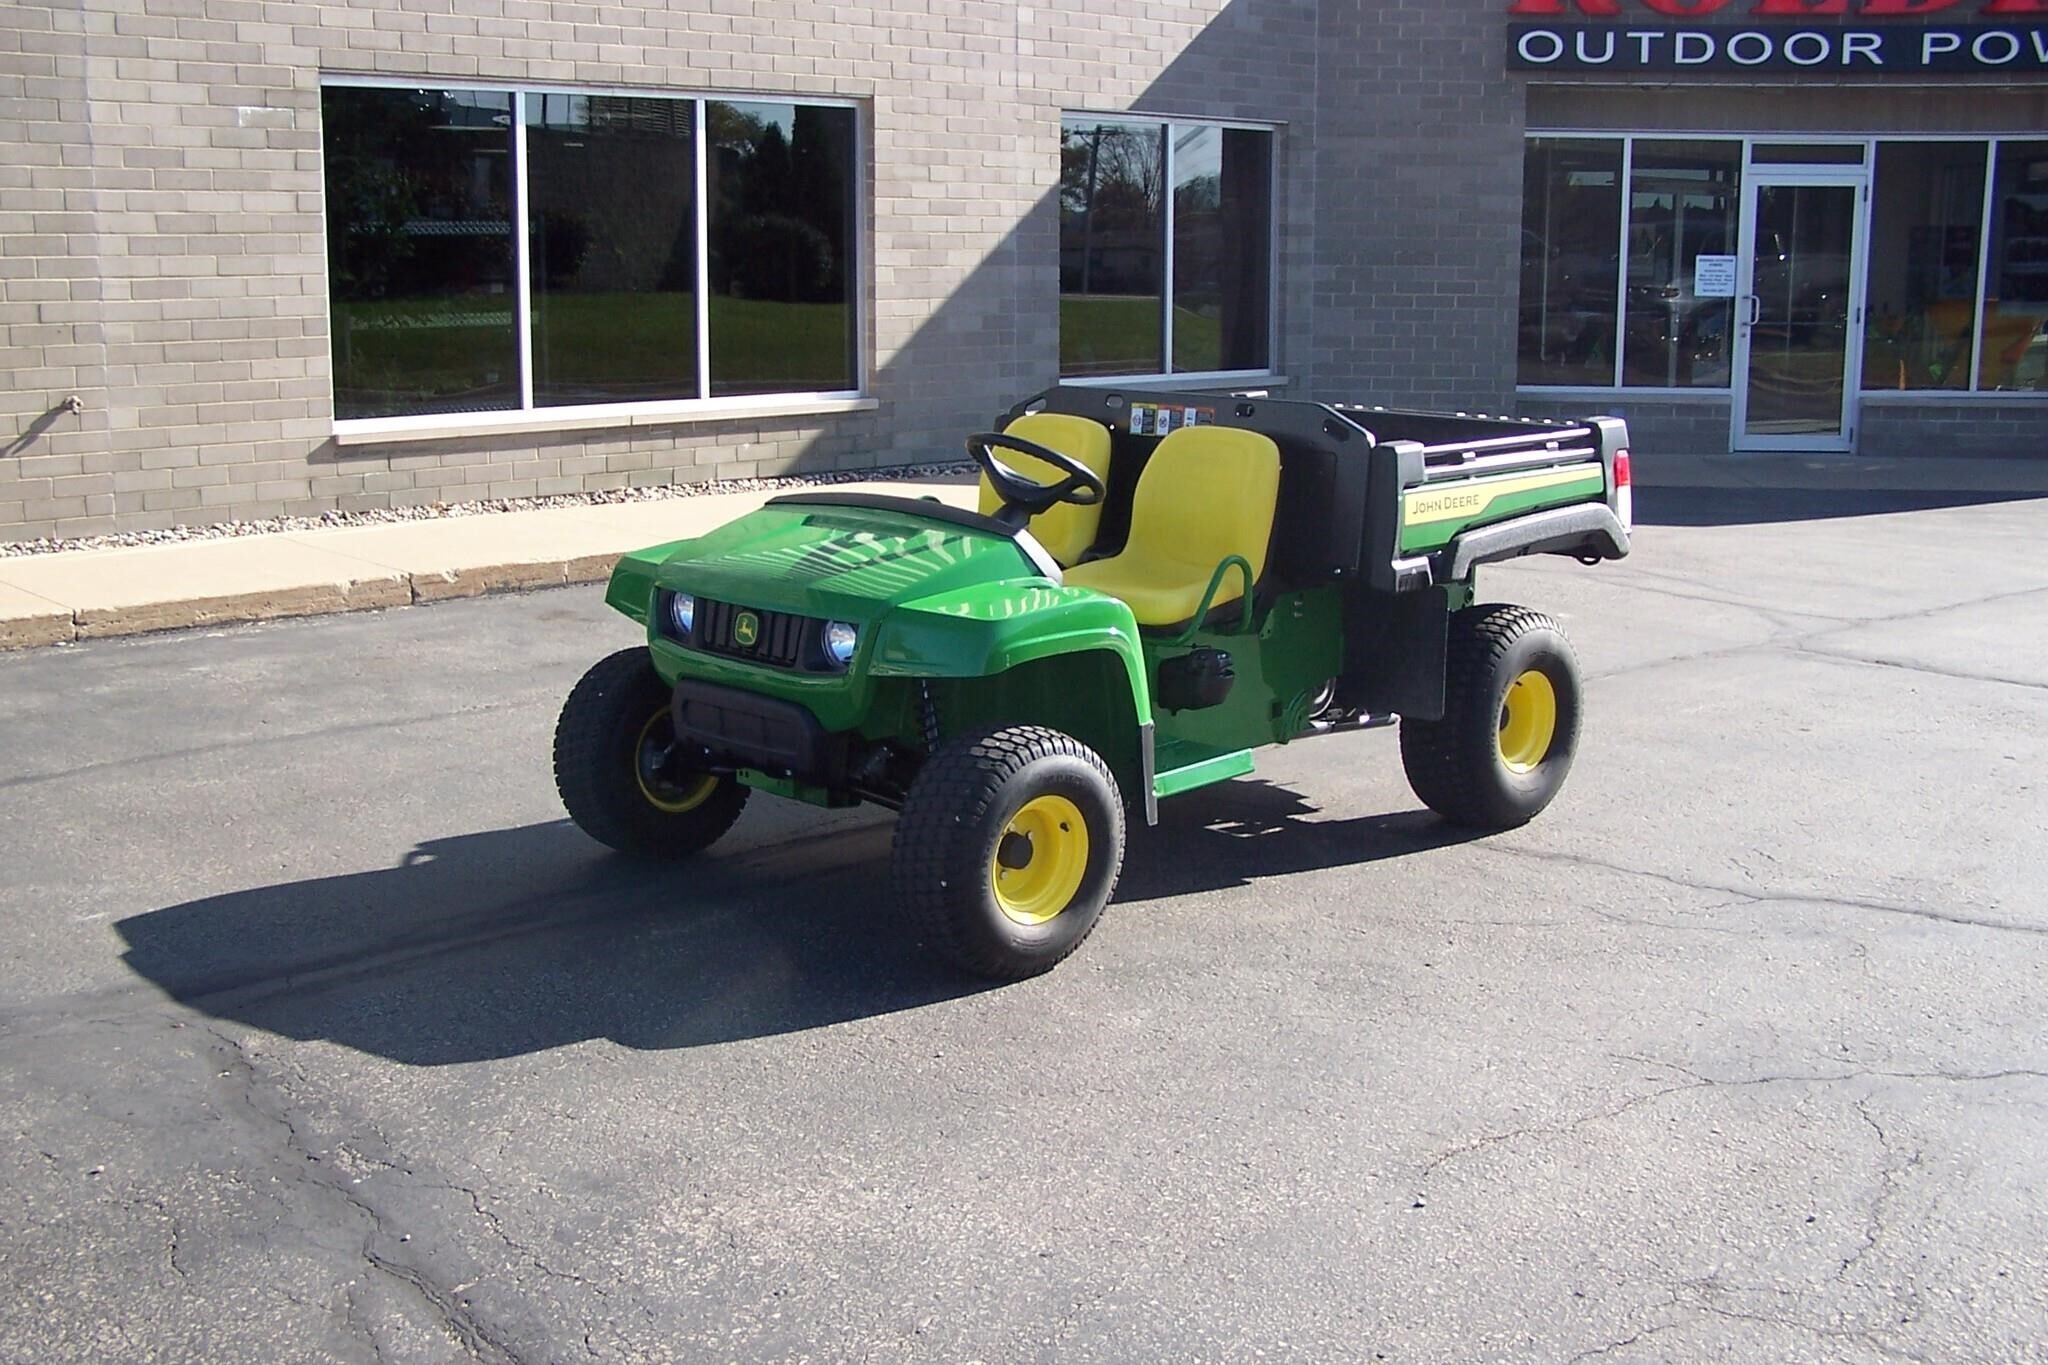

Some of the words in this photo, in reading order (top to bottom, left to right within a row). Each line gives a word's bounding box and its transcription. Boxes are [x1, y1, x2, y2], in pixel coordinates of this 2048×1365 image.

[1516, 29, 1884, 65] OUTDOOR
[1412, 500, 1441, 514] JOHN
[1444, 494, 1479, 509] DEERE
